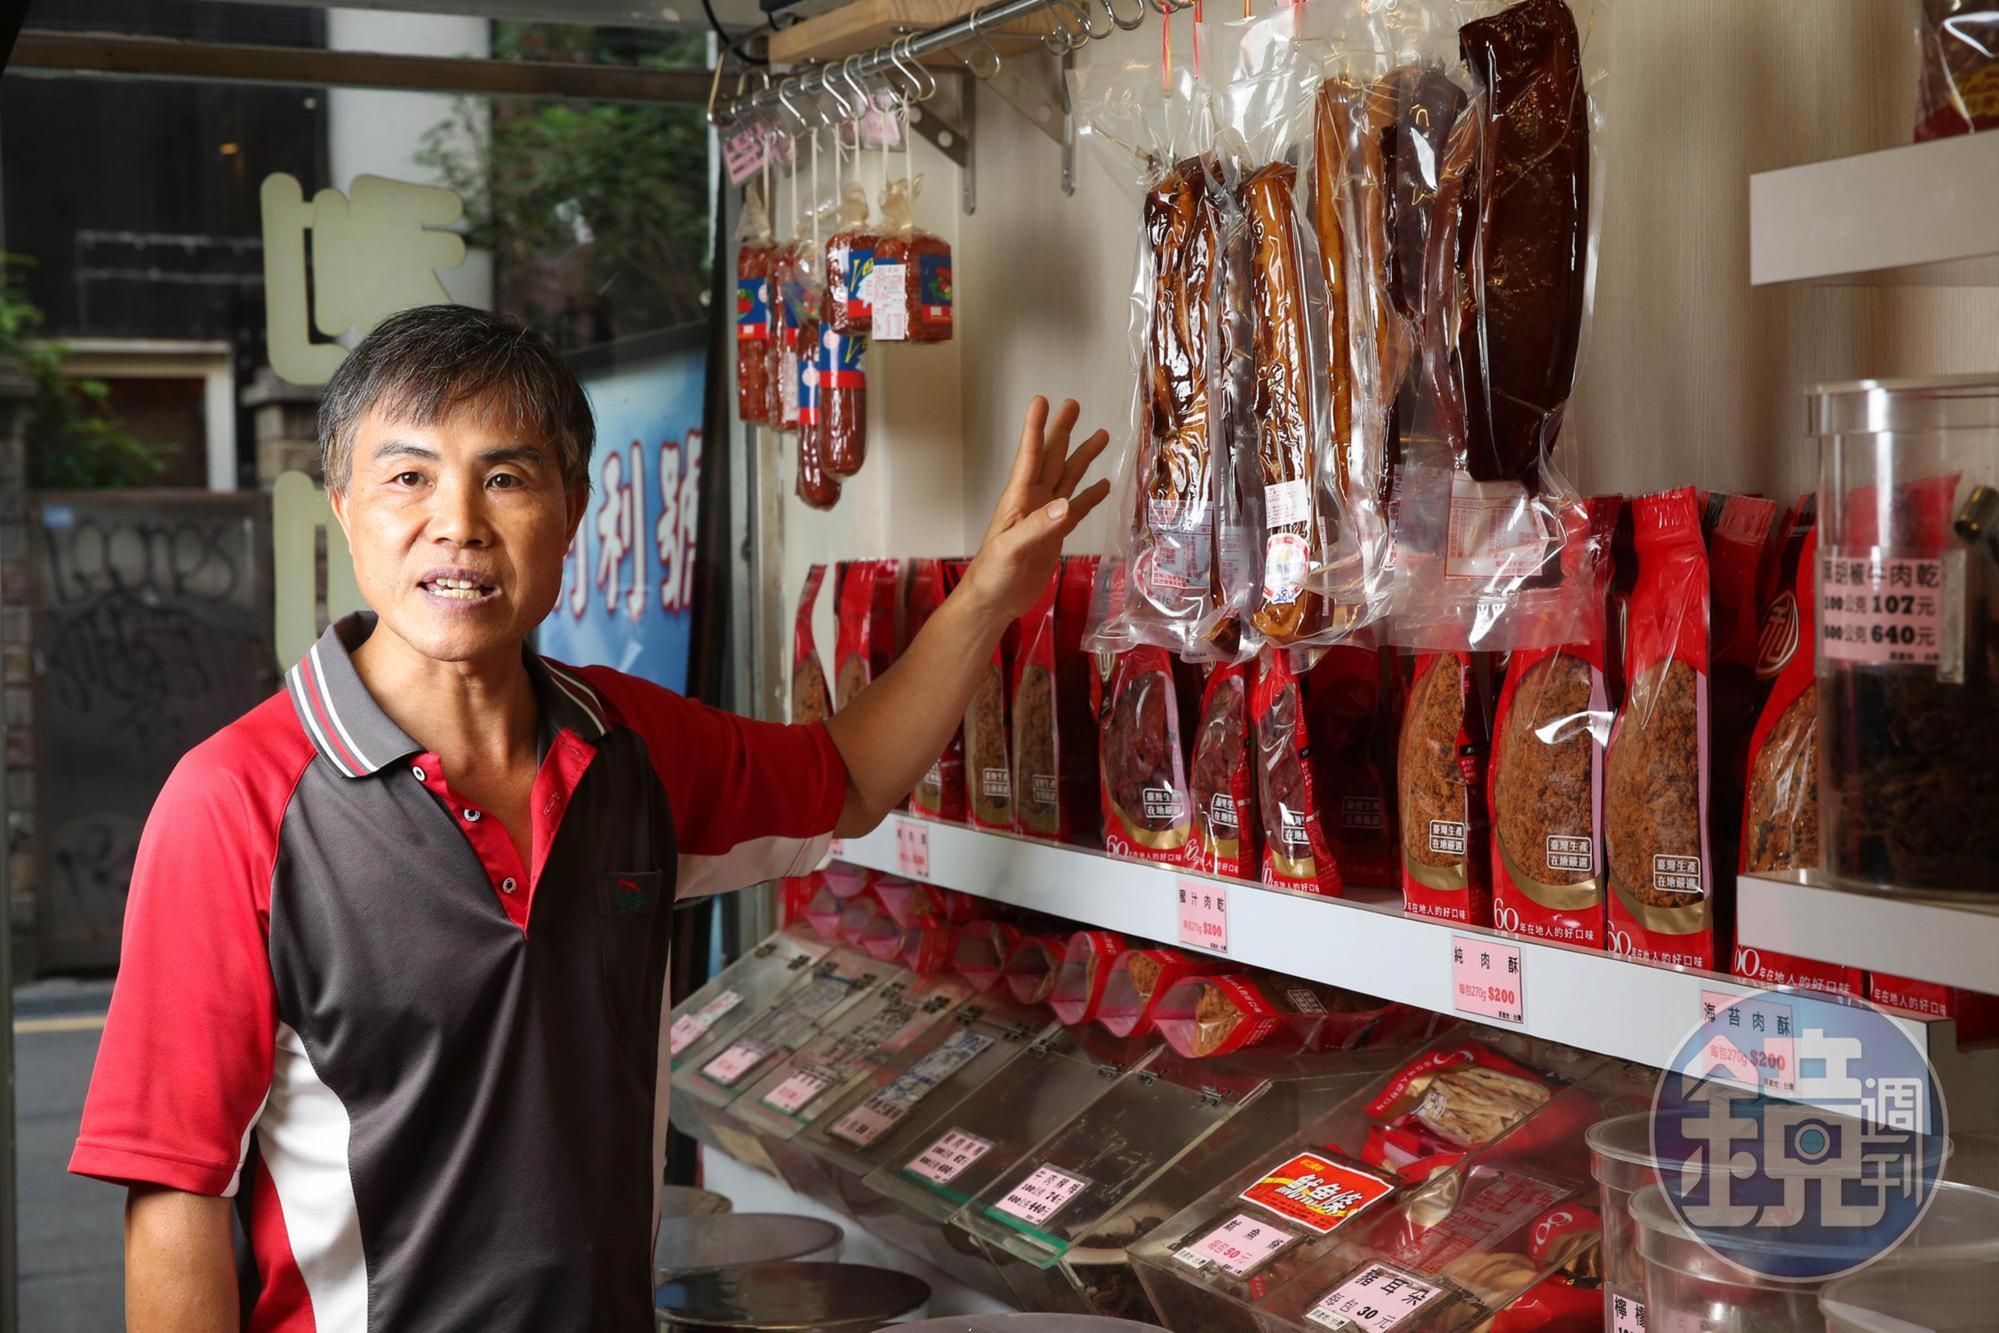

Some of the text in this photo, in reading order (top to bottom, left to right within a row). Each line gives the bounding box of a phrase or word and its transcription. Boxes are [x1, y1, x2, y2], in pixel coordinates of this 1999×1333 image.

[1872, 595, 1936, 617] 107元
[1871, 624, 1936, 647] 640元
[1488, 986, 1515, 1005] $200
[1704, 1002, 1791, 1036] 海苔肉酥
[1750, 1049, 1786, 1071] $200
[1355, 1269, 1430, 1307] 豬耳朵
[1325, 1292, 1396, 1330] 每包30元
